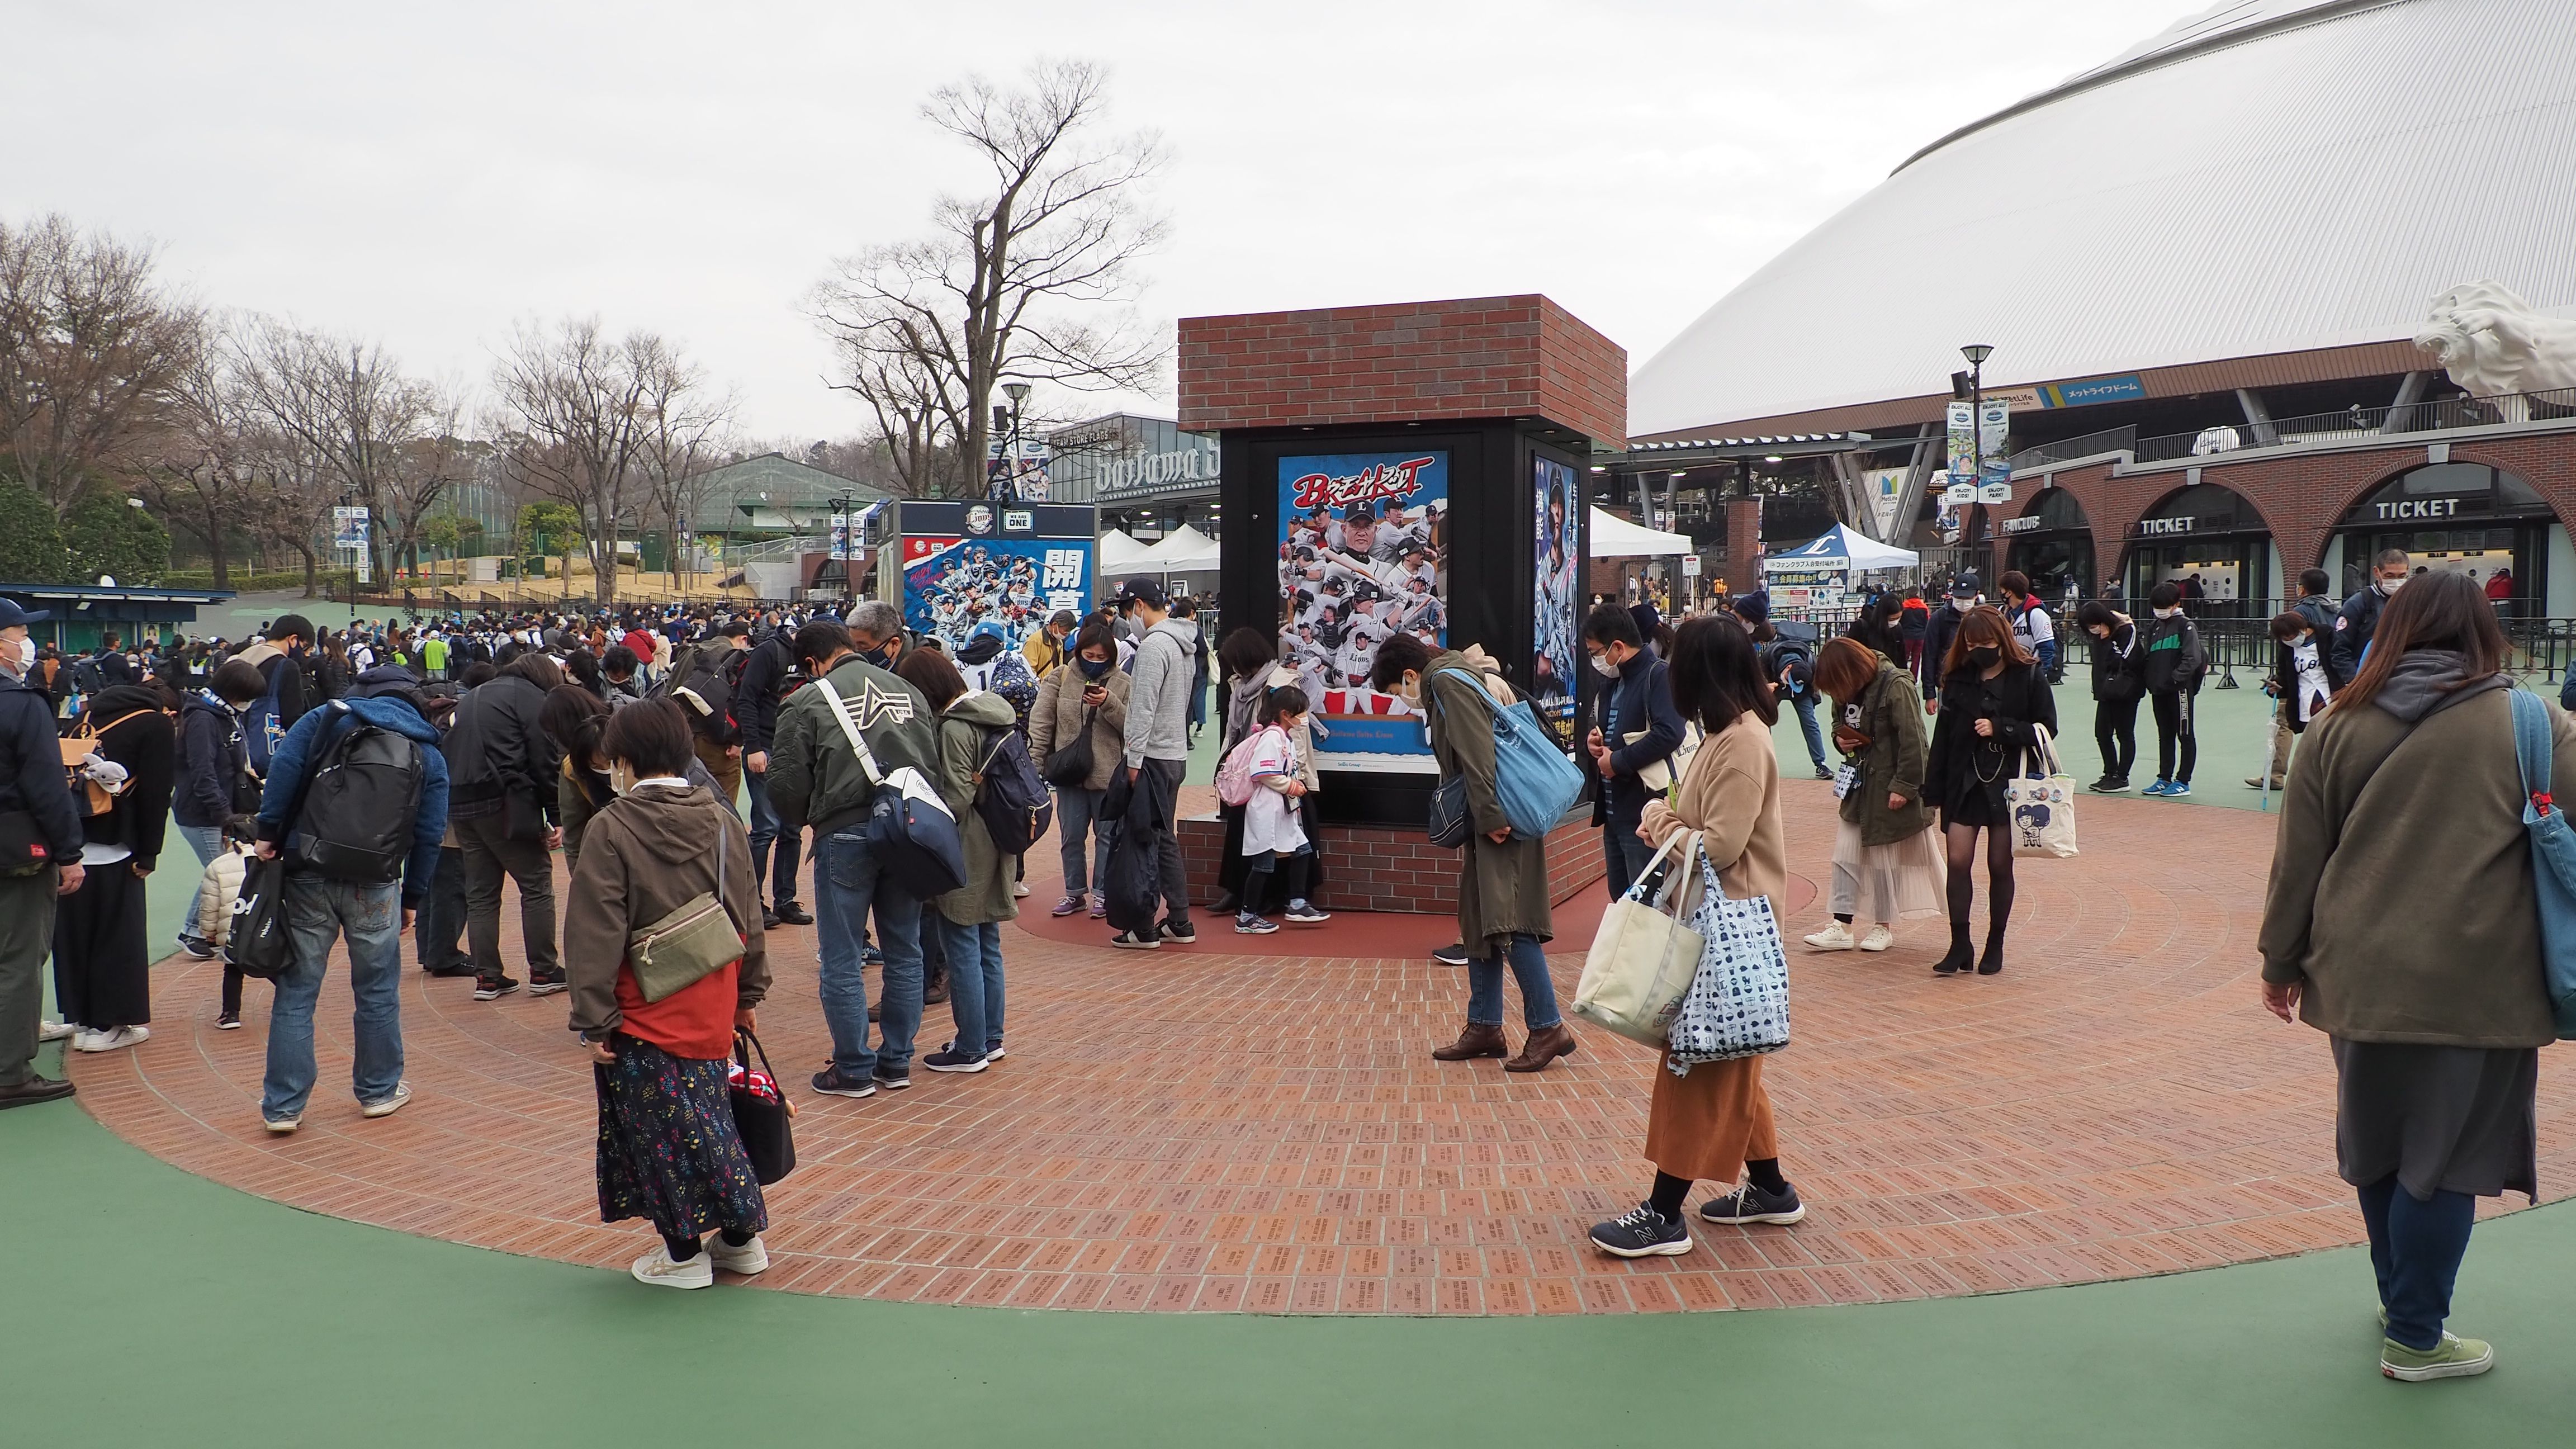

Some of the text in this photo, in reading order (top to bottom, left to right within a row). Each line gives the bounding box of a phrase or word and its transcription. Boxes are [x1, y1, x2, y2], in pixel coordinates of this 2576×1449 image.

[2068, 383, 2138, 397] メットライフドーム
[1069, 435, 1088, 447] STORE
[1090, 430, 1109, 442] FLAGS
[1095, 442, 1199, 491] Saitama
[2376, 498, 2459, 519] TICKET
[965, 512, 993, 524] Lions
[2002, 516, 2040, 532] FANCLUB
[2141, 517, 2195, 534] TICKET
[1801, 535, 1837, 555] L
[1536, 487, 1544, 627] 堪能しよう。
[1776, 560, 1835, 568] ファンクラブ入会受付場所
[1042, 550, 1085, 623] 開幕
[1779, 574, 1817, 584] 会員募集中!!
